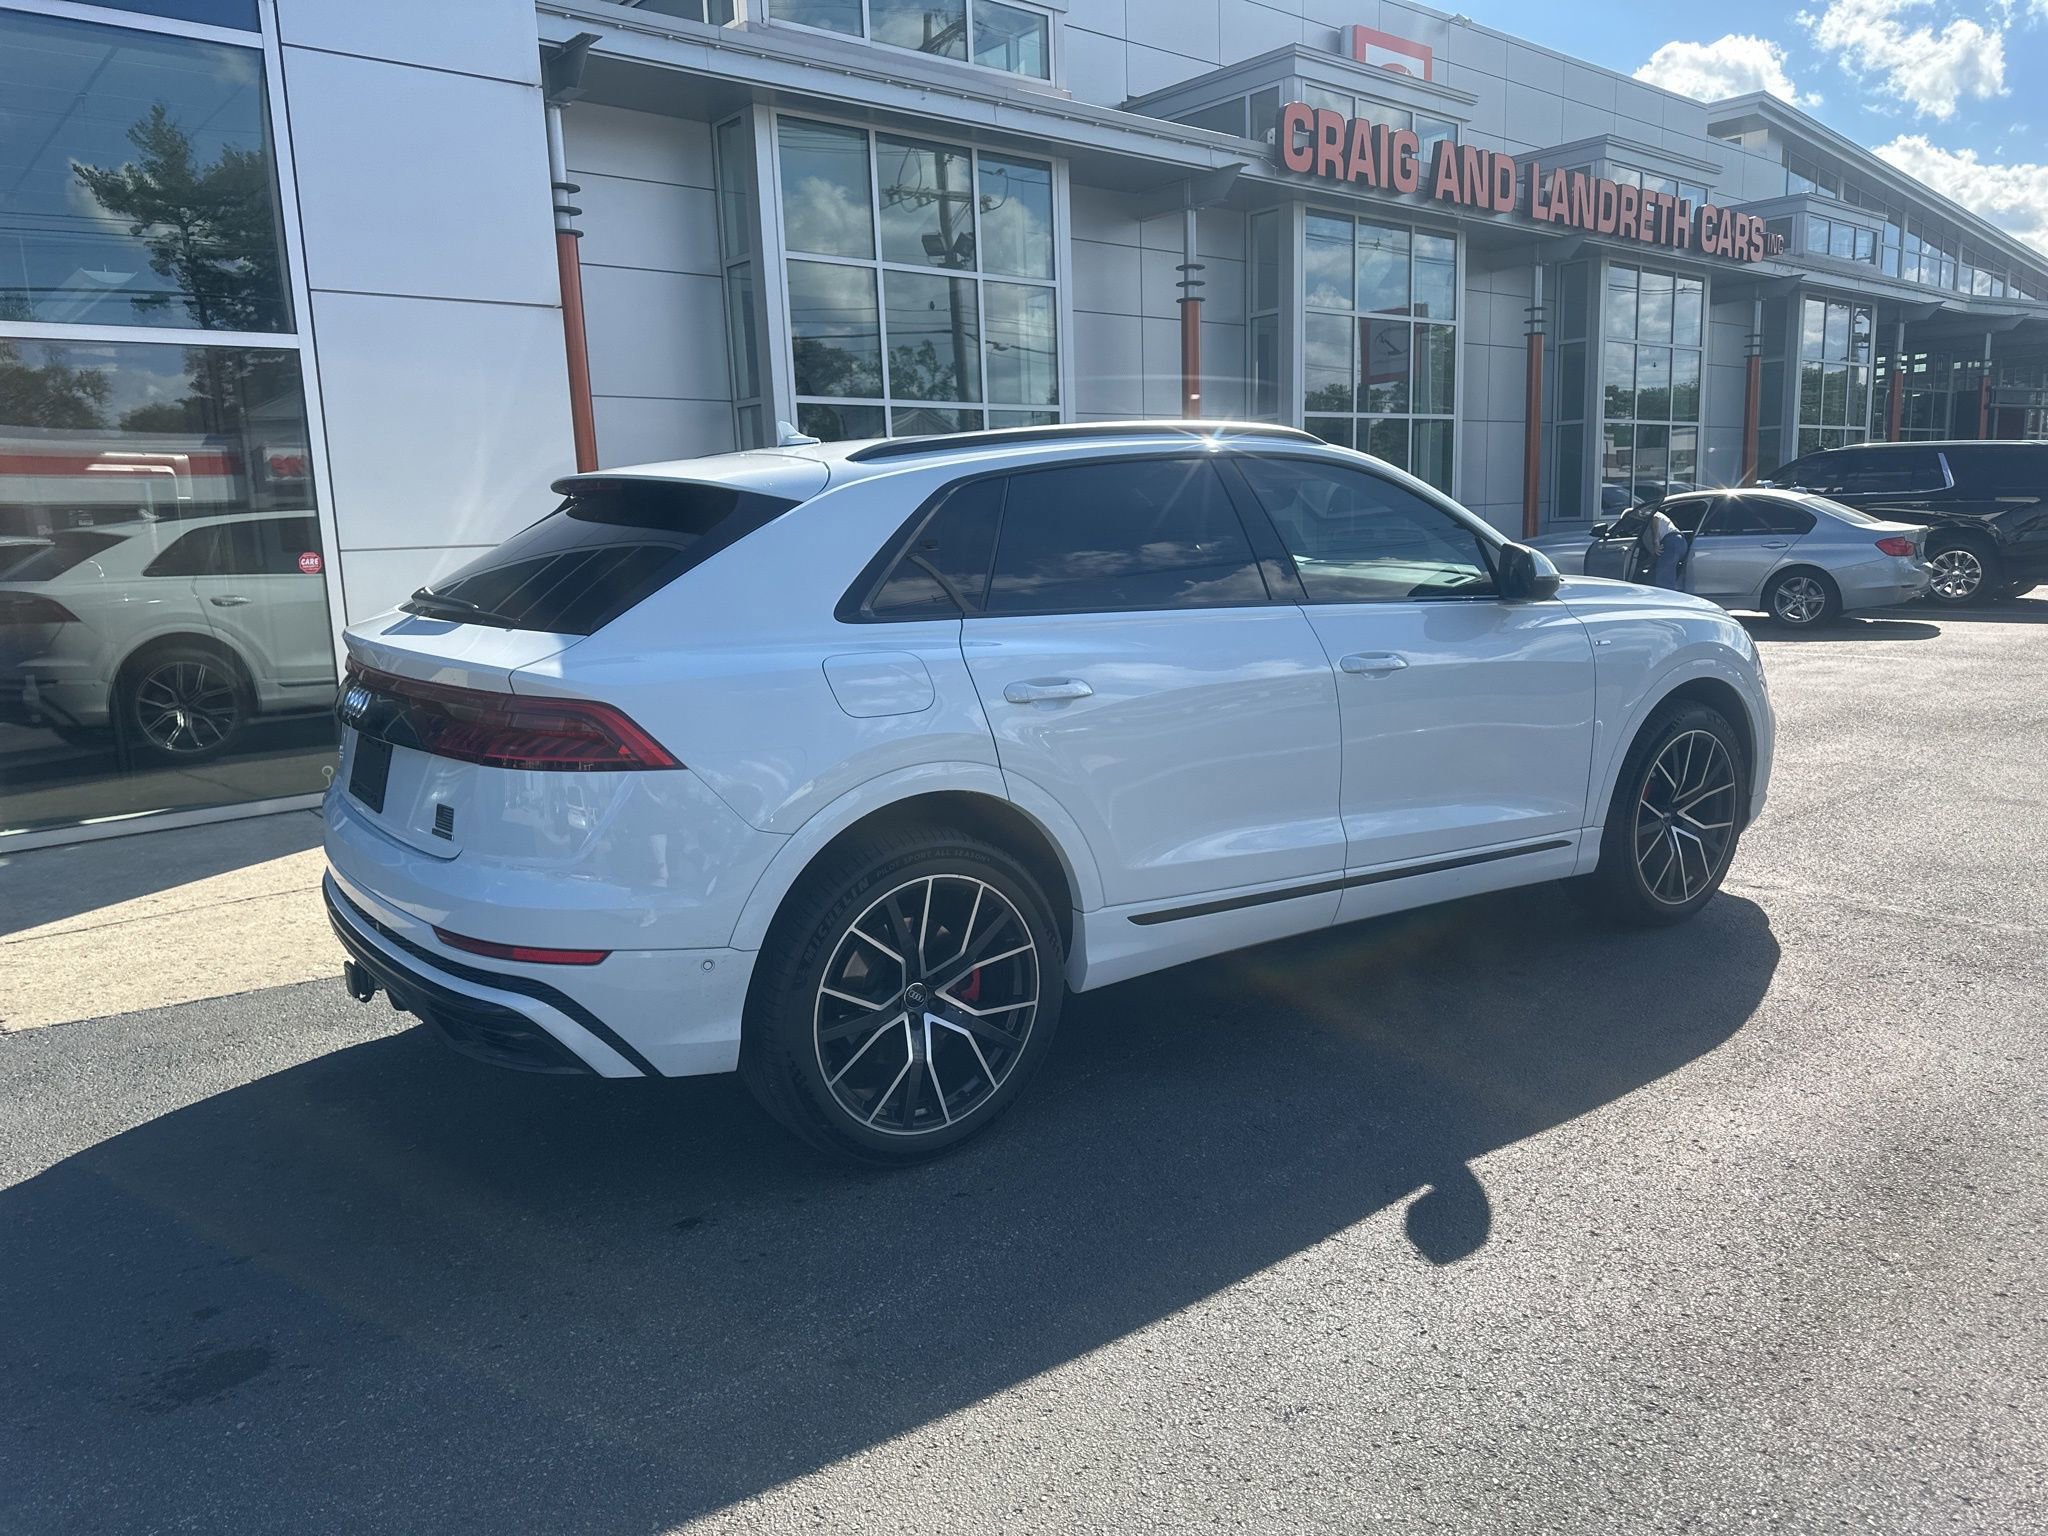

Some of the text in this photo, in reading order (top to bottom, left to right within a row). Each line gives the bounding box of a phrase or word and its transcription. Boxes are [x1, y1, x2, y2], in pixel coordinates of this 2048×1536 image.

[1280, 101, 1420, 194] CRAIG
[1432, 139, 1518, 213] AND
[1529, 160, 1692, 249] LANDRETH
[1698, 203, 1765, 263] CARS
[802, 876, 871, 964] MICHELIN
